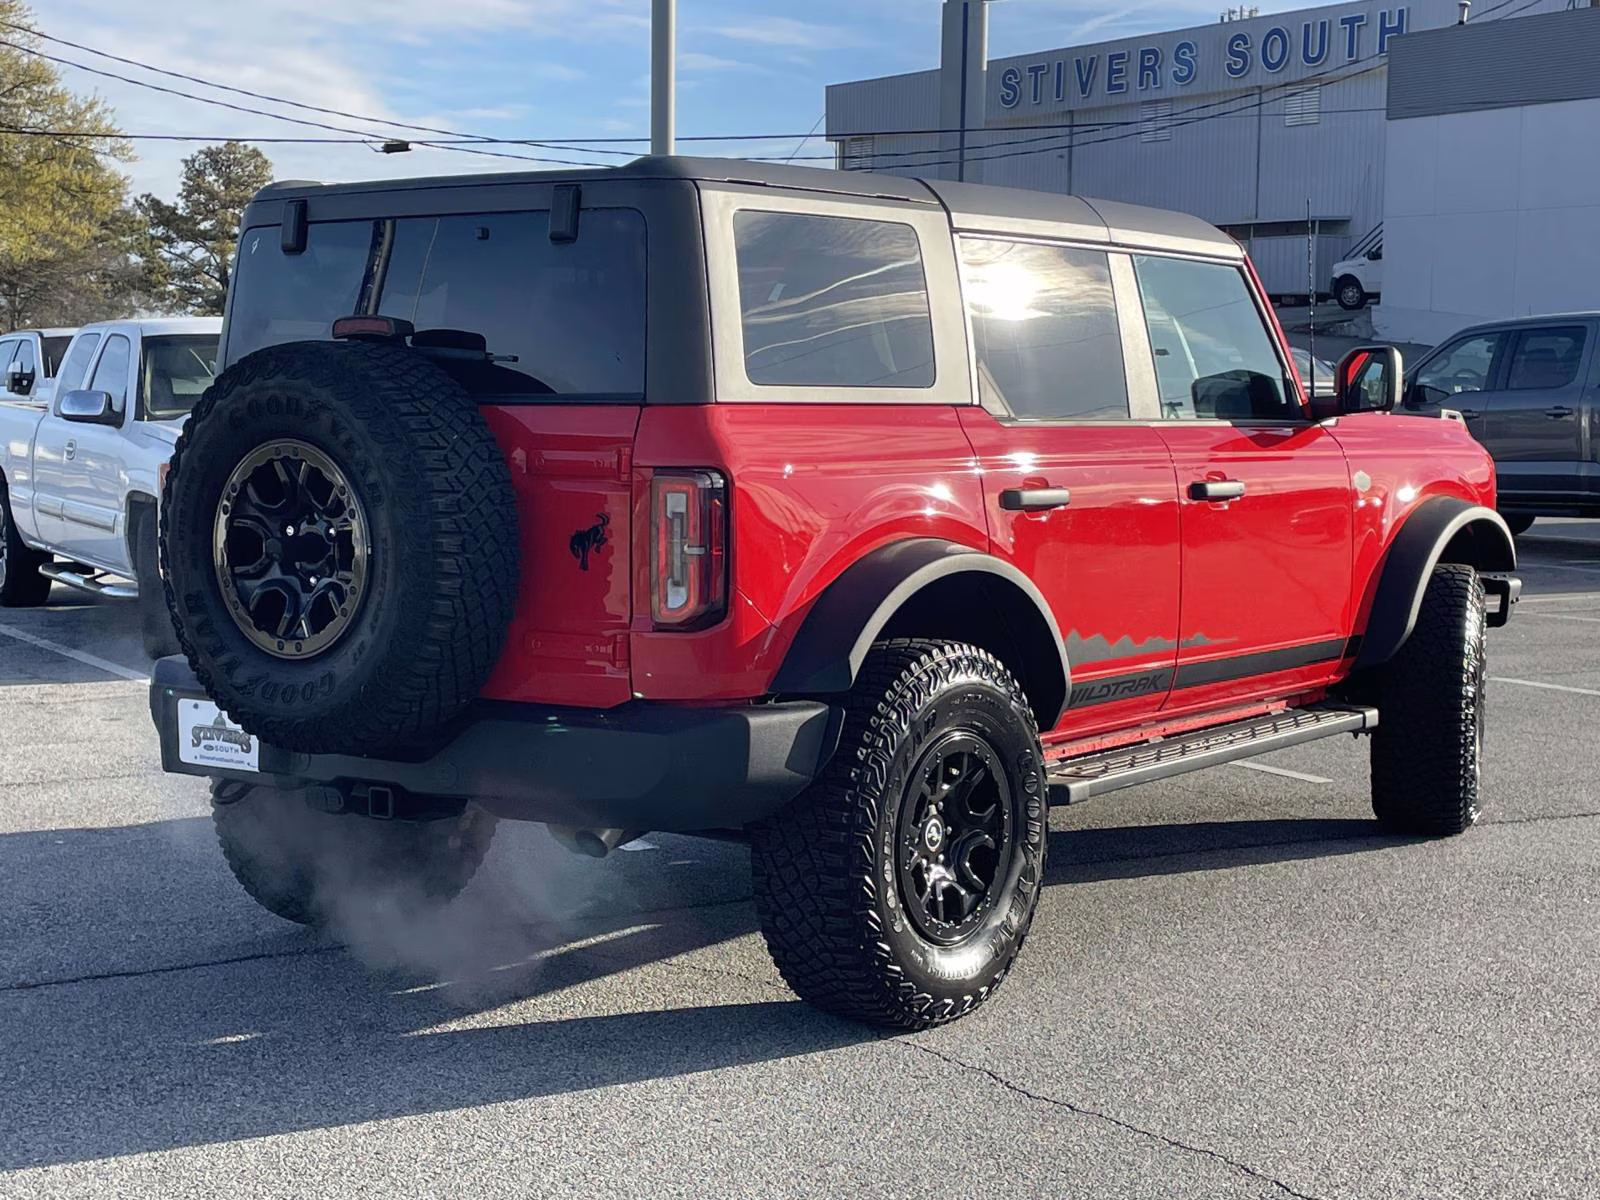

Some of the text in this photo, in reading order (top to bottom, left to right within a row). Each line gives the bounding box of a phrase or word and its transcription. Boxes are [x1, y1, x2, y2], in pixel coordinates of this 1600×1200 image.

[1000, 8, 1410, 108] STIVERS SOUTH
[184, 589, 337, 706] GOODYEAR
[1070, 673, 1164, 706] WILDTRAK
[214, 745, 240, 755] SOUTH
[986, 749, 1042, 960] GOODYEAR
